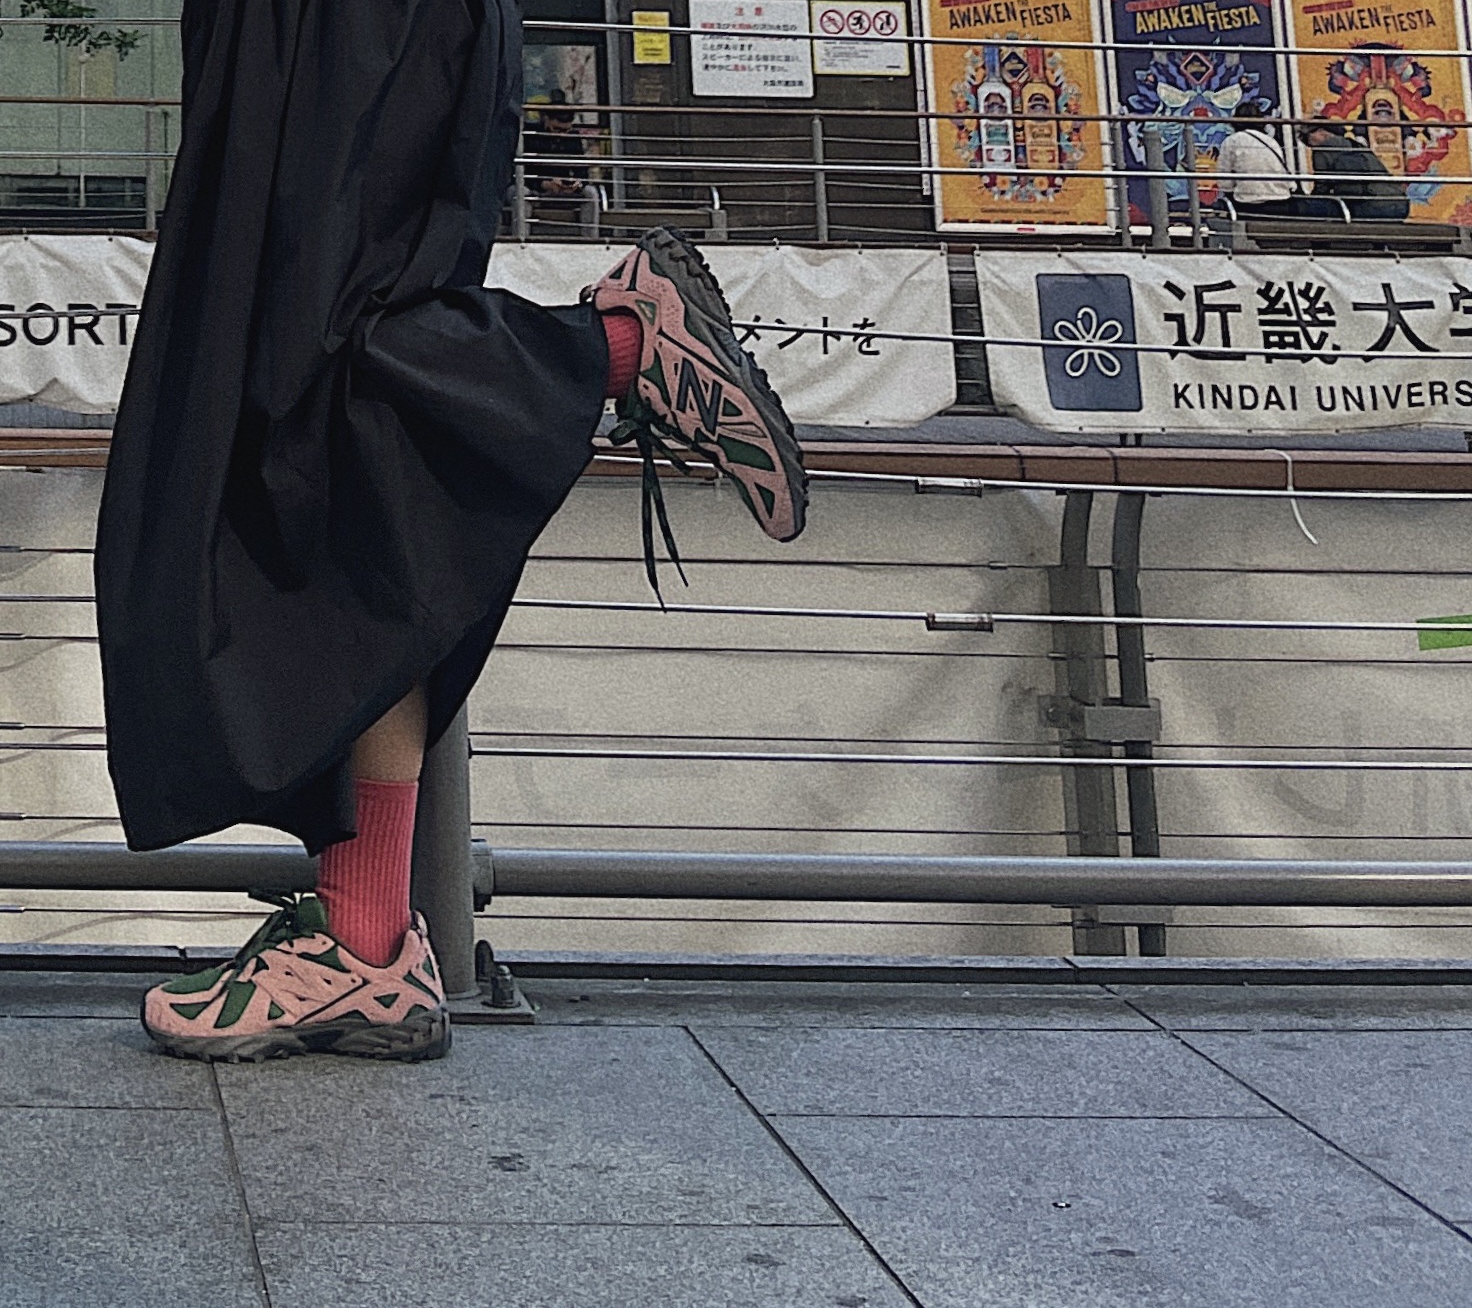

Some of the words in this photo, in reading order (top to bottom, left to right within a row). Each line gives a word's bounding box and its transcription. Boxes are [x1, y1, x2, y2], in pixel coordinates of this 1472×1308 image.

[949, 1, 1018, 30] AWAKEN
[1019, 3, 1072, 28] FIESTA
[1134, 2, 1207, 34] AWAKEN
[1206, 4, 1261, 32] FIESTA
[1312, 6, 1381, 36] AWAKEN
[1382, 8, 1436, 34] FIESTA
[1173, 383, 1298, 412] KINDAI
